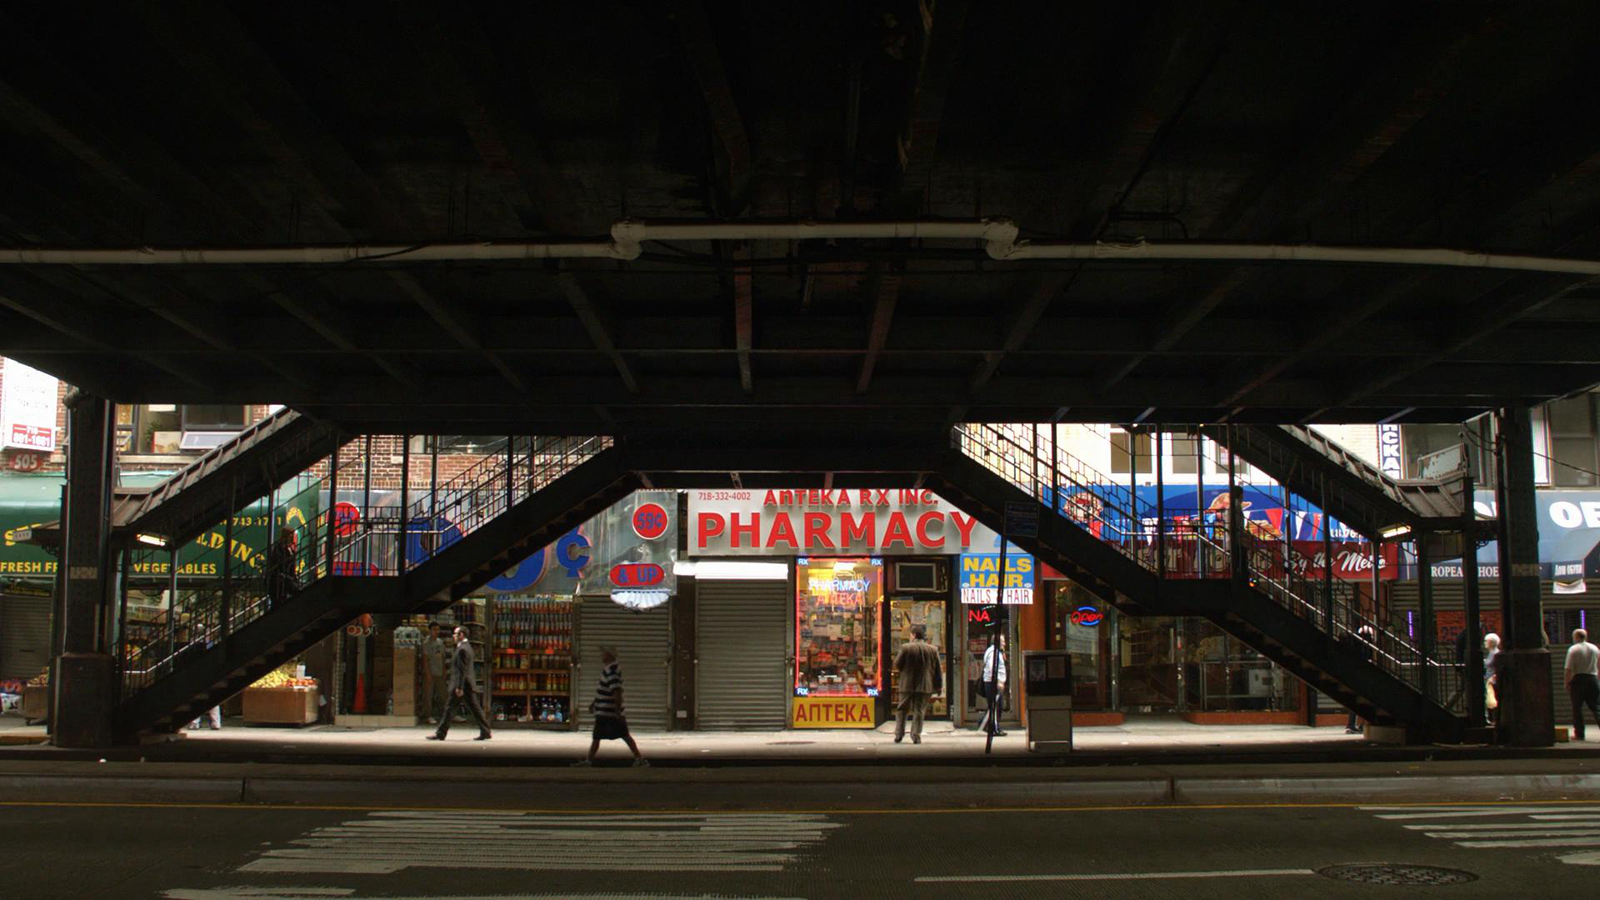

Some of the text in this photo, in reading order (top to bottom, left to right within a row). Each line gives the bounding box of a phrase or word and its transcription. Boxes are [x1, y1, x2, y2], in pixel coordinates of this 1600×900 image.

[14, 454, 37, 469] 505
[698, 492, 751, 501] 718-332-4002
[858, 489, 889, 507] RX
[897, 489, 938, 507] INC.
[697, 511, 978, 549] PHARMACY
[0, 561, 41, 573] FRESH
[963, 558, 1031, 572] NAILS
[637, 567, 658, 583] UP
[970, 574, 1024, 587] HAIR
[808, 577, 871, 592] PHARMACY
[963, 589, 1030, 604] NAILS HAIR
